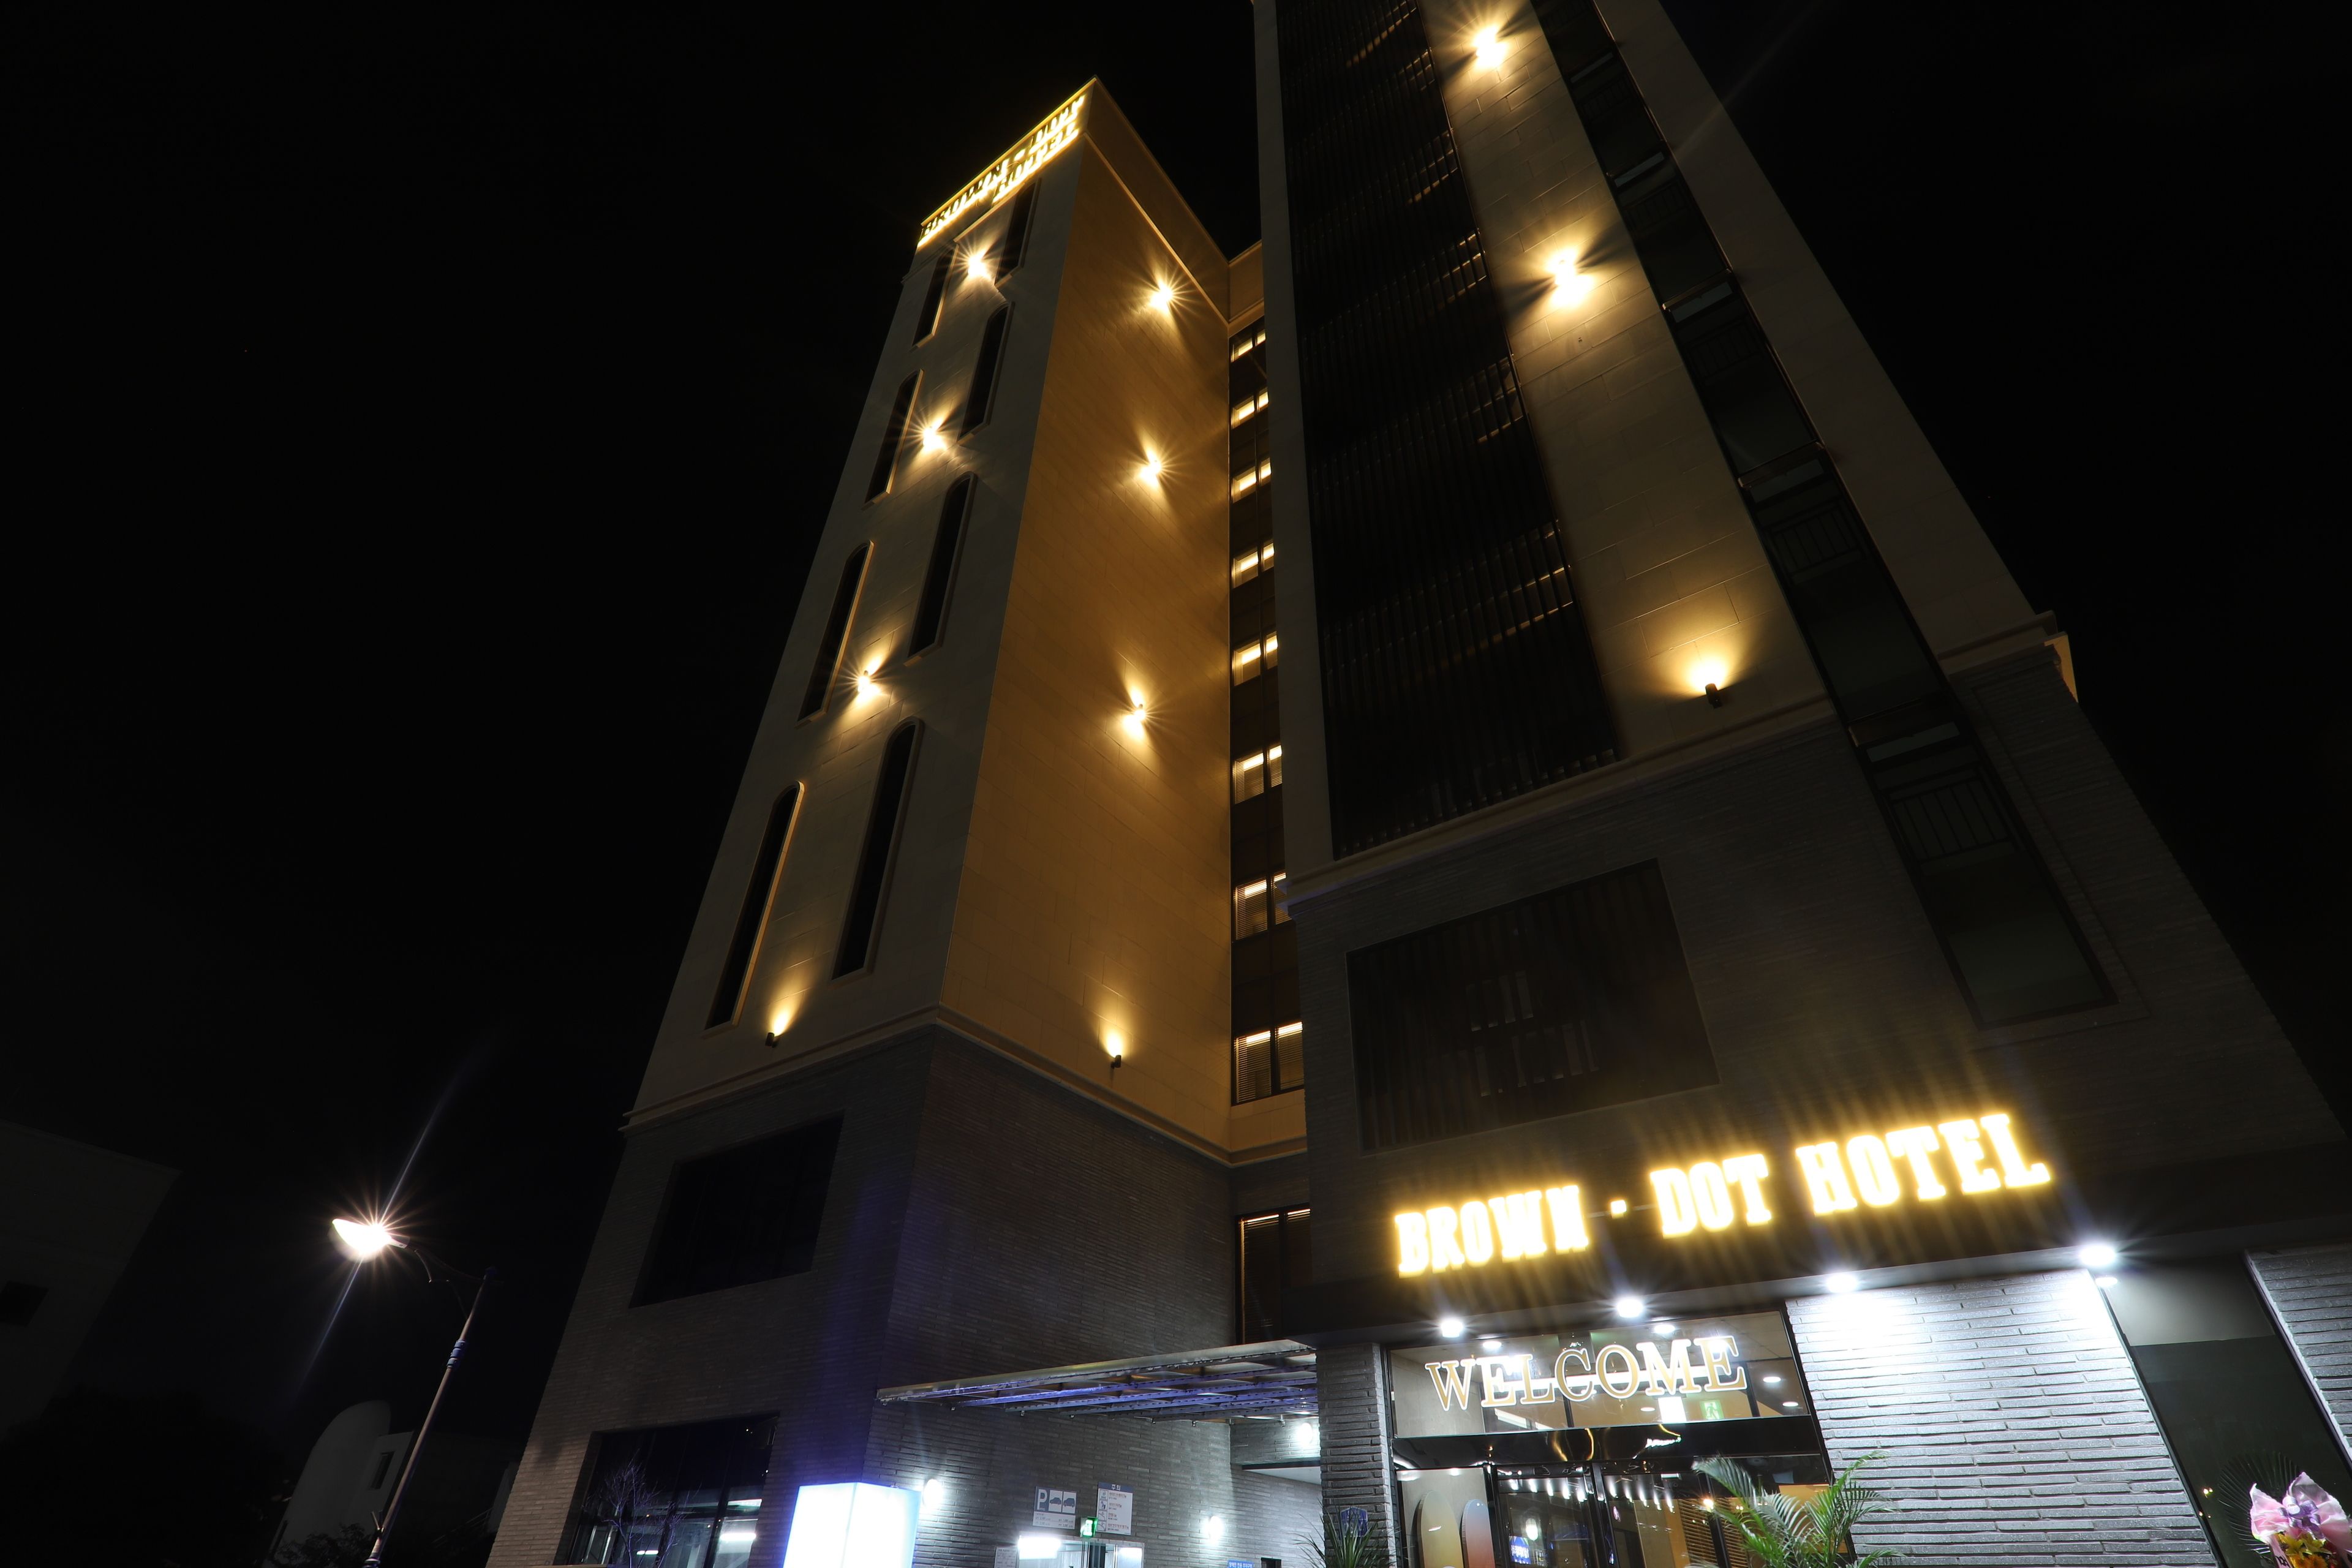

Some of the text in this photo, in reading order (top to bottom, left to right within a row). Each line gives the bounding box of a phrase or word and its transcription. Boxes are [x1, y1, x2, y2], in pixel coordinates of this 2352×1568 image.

[1395, 1113, 2050, 1278] BROWN DOT HOTEL
[1425, 1336, 1747, 1411] WELCOME
[1036, 1488, 1047, 1510] P
